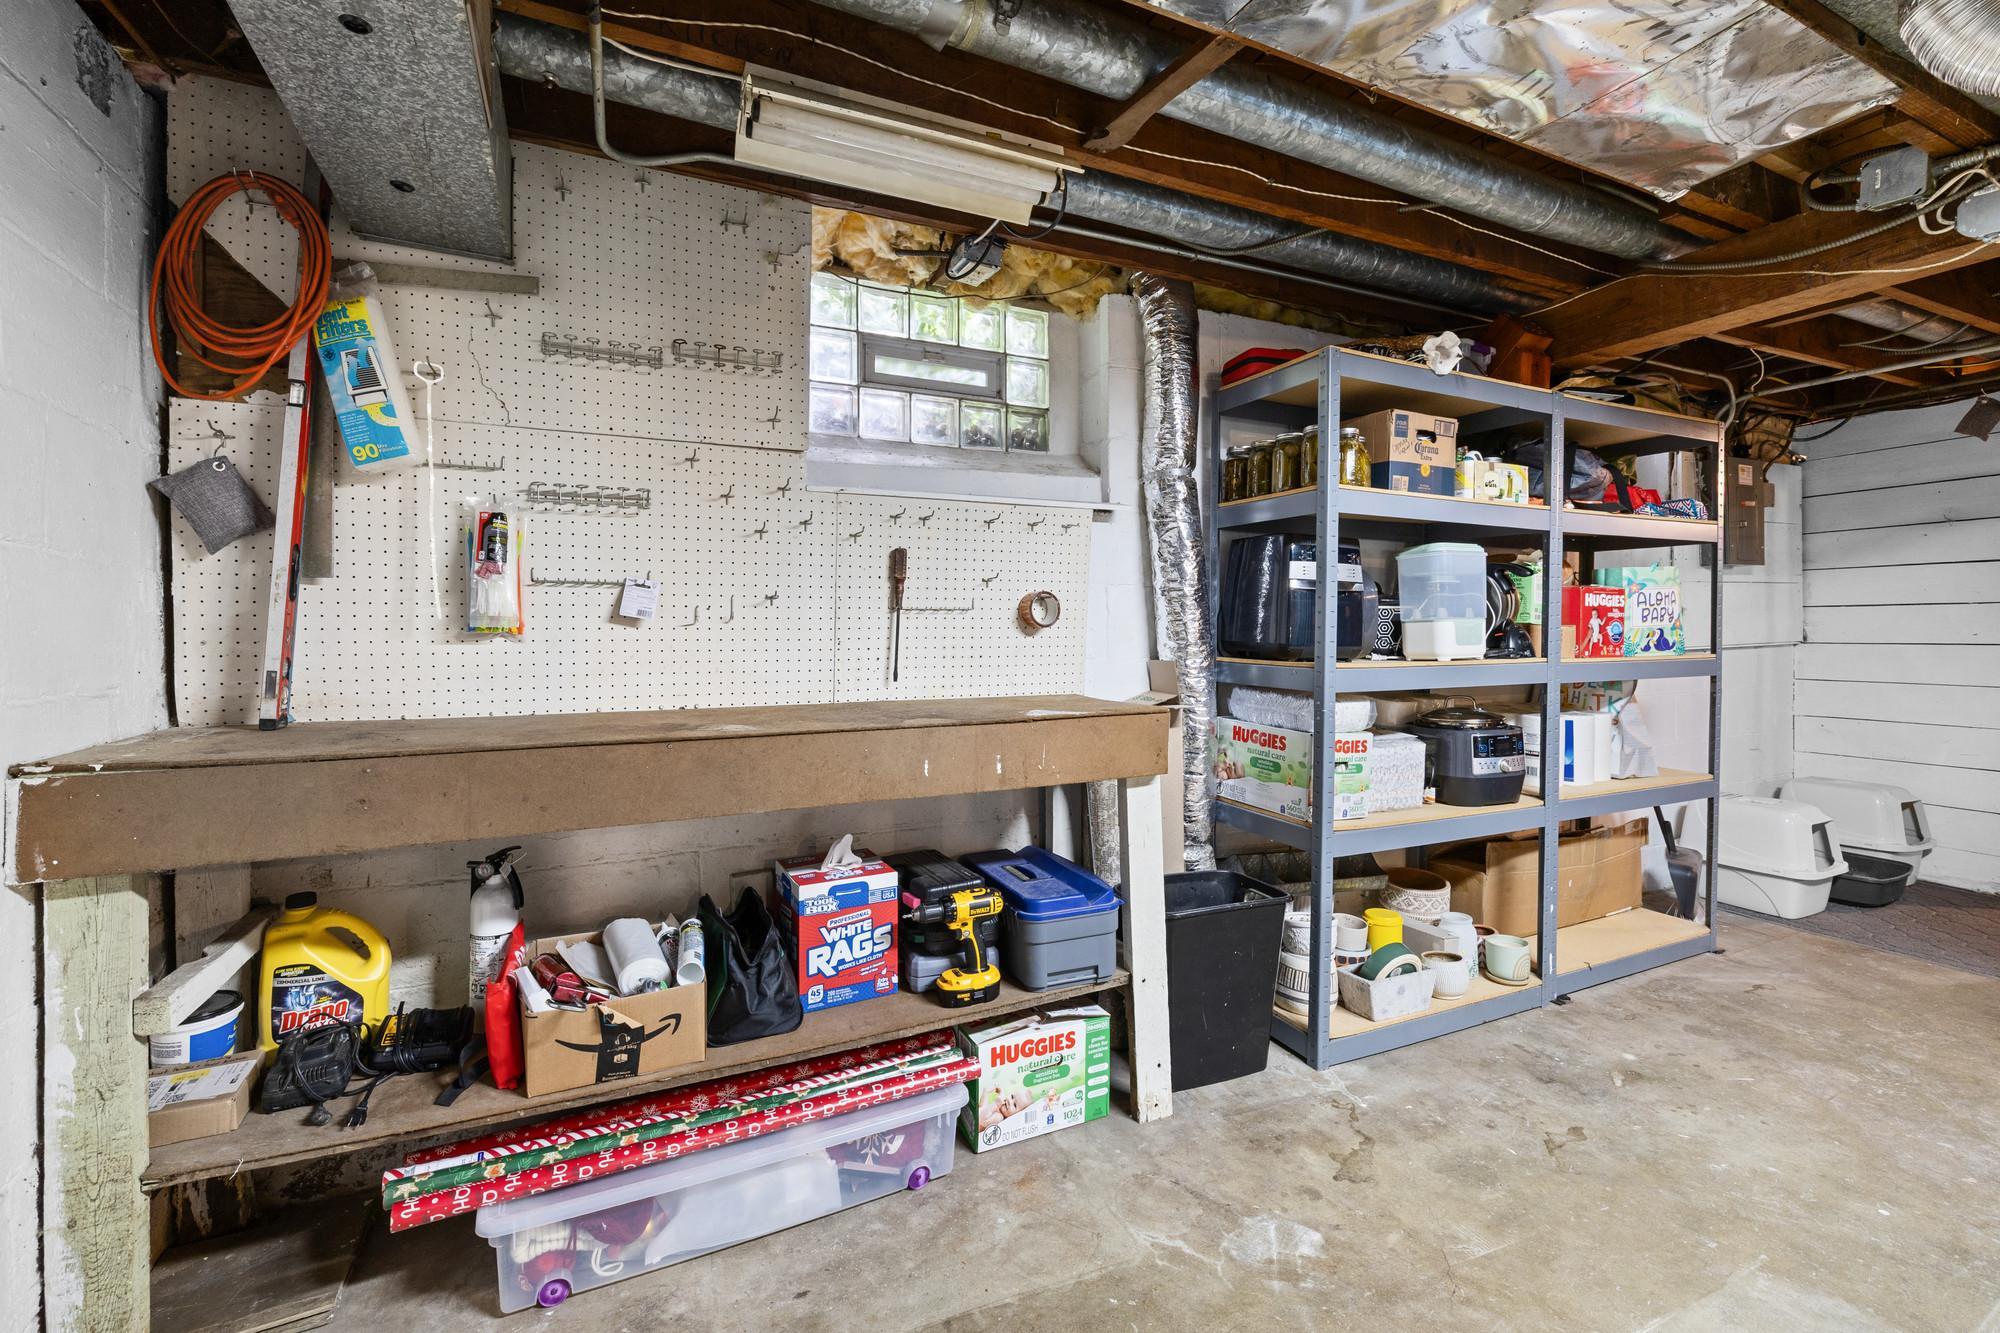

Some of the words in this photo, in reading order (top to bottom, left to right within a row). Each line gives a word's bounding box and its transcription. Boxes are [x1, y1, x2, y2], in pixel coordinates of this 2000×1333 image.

[317, 319, 368, 339] Filters
[352, 443, 380, 461] 90
[1414, 441, 1439, 455] Corona
[1420, 453, 1432, 461] Extra
[1585, 592, 1625, 607] HUGGIES
[1636, 590, 1677, 608] ALOHA
[1641, 608, 1675, 624] BABY
[1232, 725, 1287, 752] HUGGIES
[1334, 739, 1368, 754] GGIES
[1246, 747, 1271, 758] natural
[1271, 753, 1286, 762] care
[806, 897, 835, 907] TOOL
[882, 889, 895, 899] USA
[806, 903, 838, 915] BOX
[829, 910, 870, 926] PROFESSIONAL
[819, 918, 873, 944] WHITE
[808, 923, 892, 977] RAGS
[838, 960, 855, 970] WORKS
[856, 957, 866, 966] LIKE
[866, 953, 883, 963] CLOTH
[276, 977, 310, 985] COMMERCIAL
[811, 989, 821, 997] 45
[279, 999, 349, 1034] Drano
[991, 1030, 1076, 1068] HUGGIES
[1017, 1056, 1052, 1073] natural
[1064, 1107, 1083, 1120] 1024
[1002, 1131, 1009, 1141] DO
[1010, 1127, 1021, 1139] NOT
[1022, 1124, 1039, 1136] FLUSH
